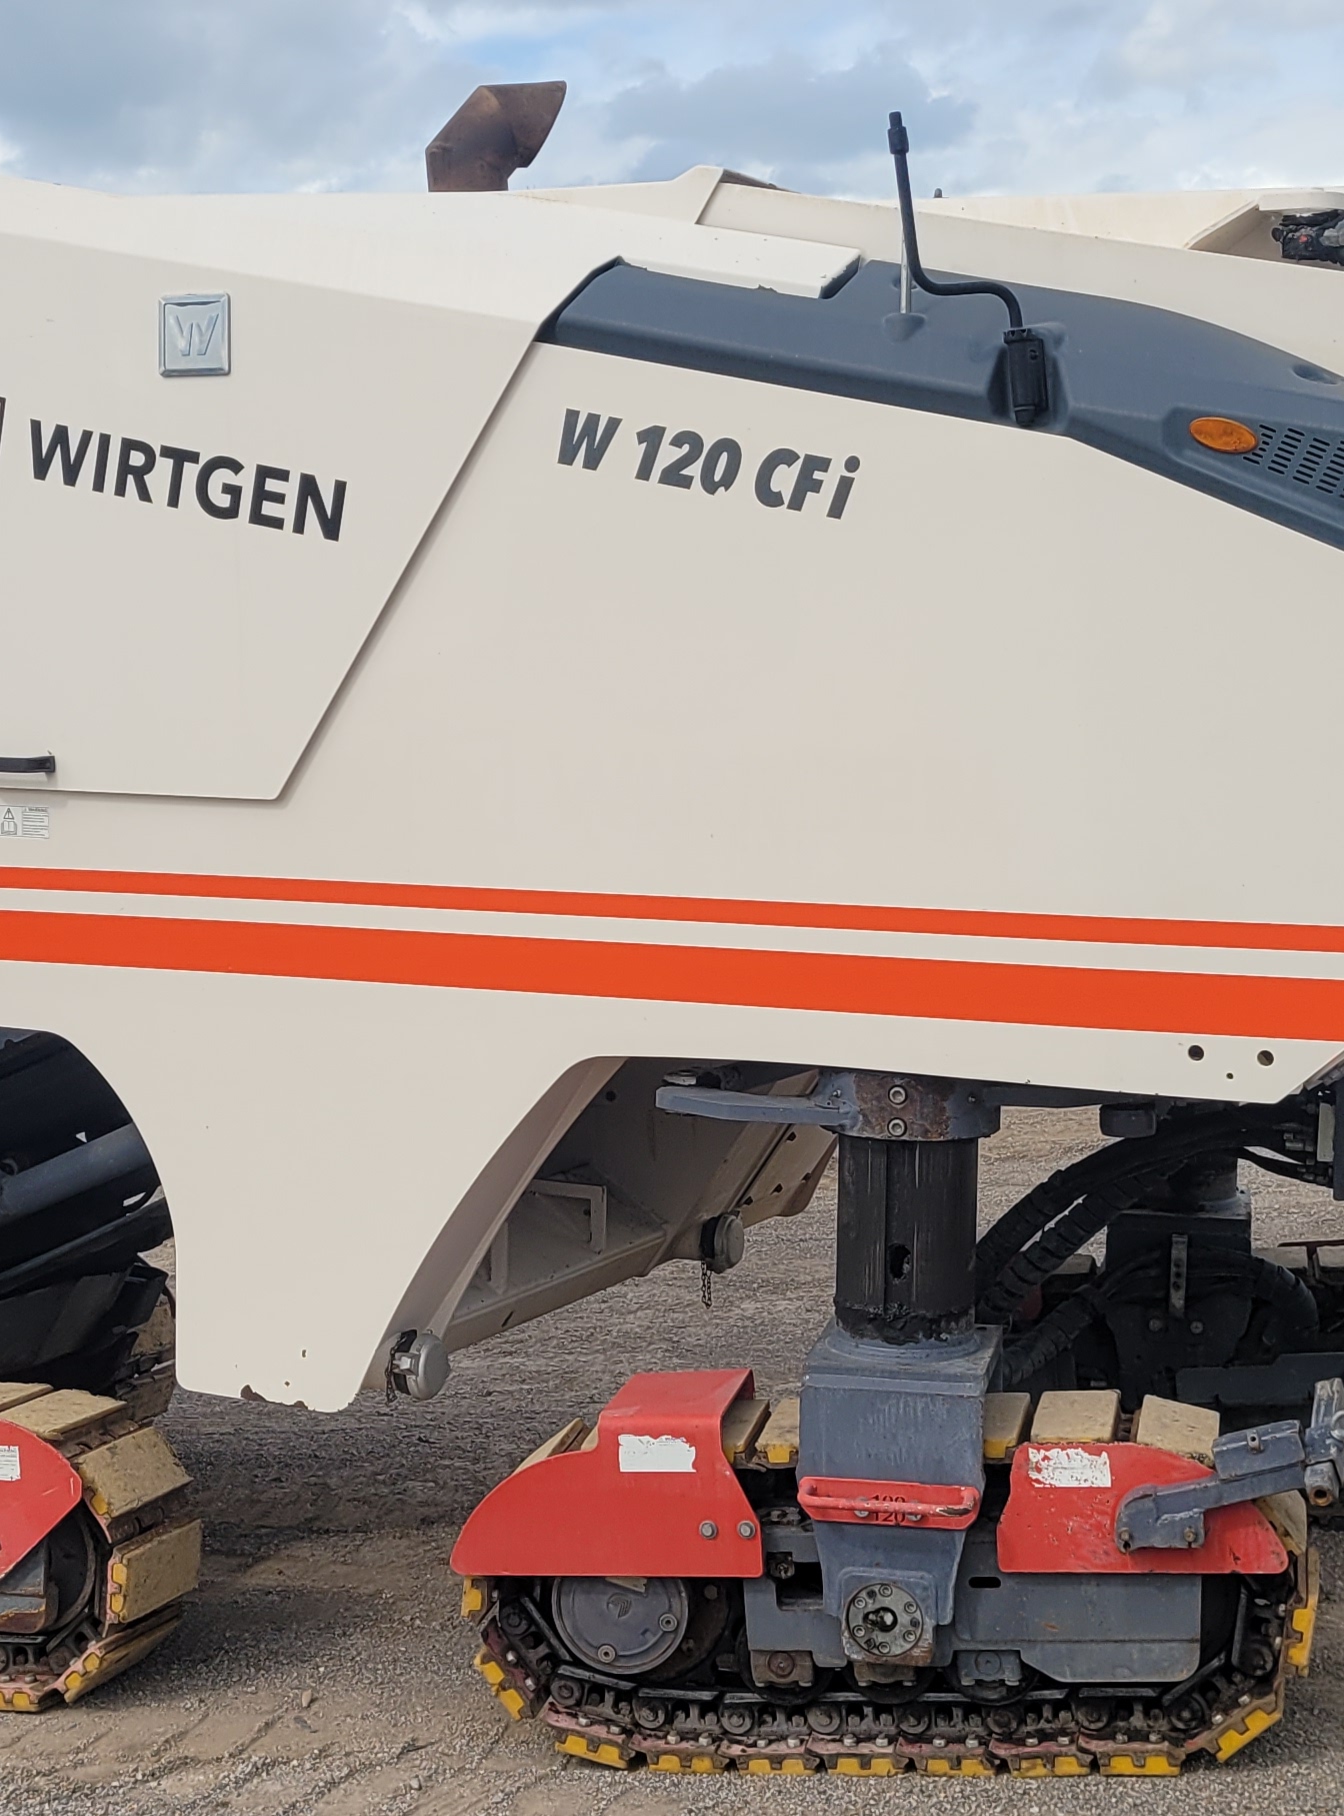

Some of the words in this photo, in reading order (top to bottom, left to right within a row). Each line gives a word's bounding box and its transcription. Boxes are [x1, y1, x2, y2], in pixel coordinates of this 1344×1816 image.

[29, 418, 347, 542] WIRTGEN
[557, 407, 623, 471] W
[634, 424, 742, 496] 120
[754, 447, 861, 520] CFi
